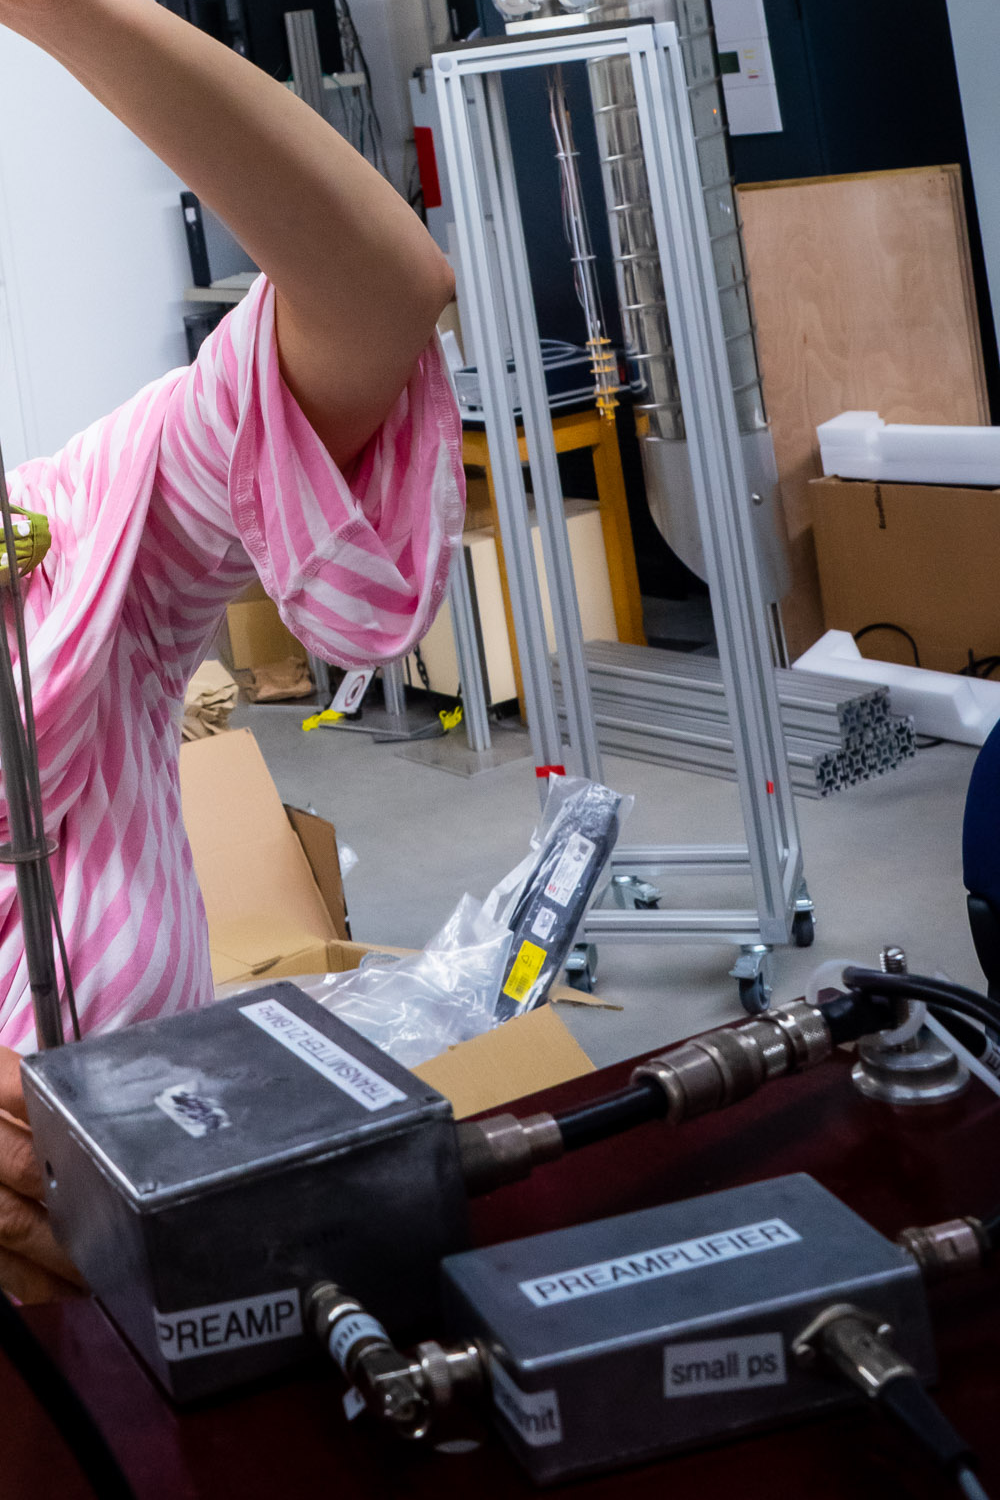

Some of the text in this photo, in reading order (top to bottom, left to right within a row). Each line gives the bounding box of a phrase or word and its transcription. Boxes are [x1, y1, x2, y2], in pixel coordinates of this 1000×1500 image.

[297, 1037, 391, 1101] TRANSMITTER
[534, 1224, 790, 1299] PREAMPLIFIER
[159, 1301, 296, 1352] PREAMP
[671, 1352, 778, 1386] small ps
